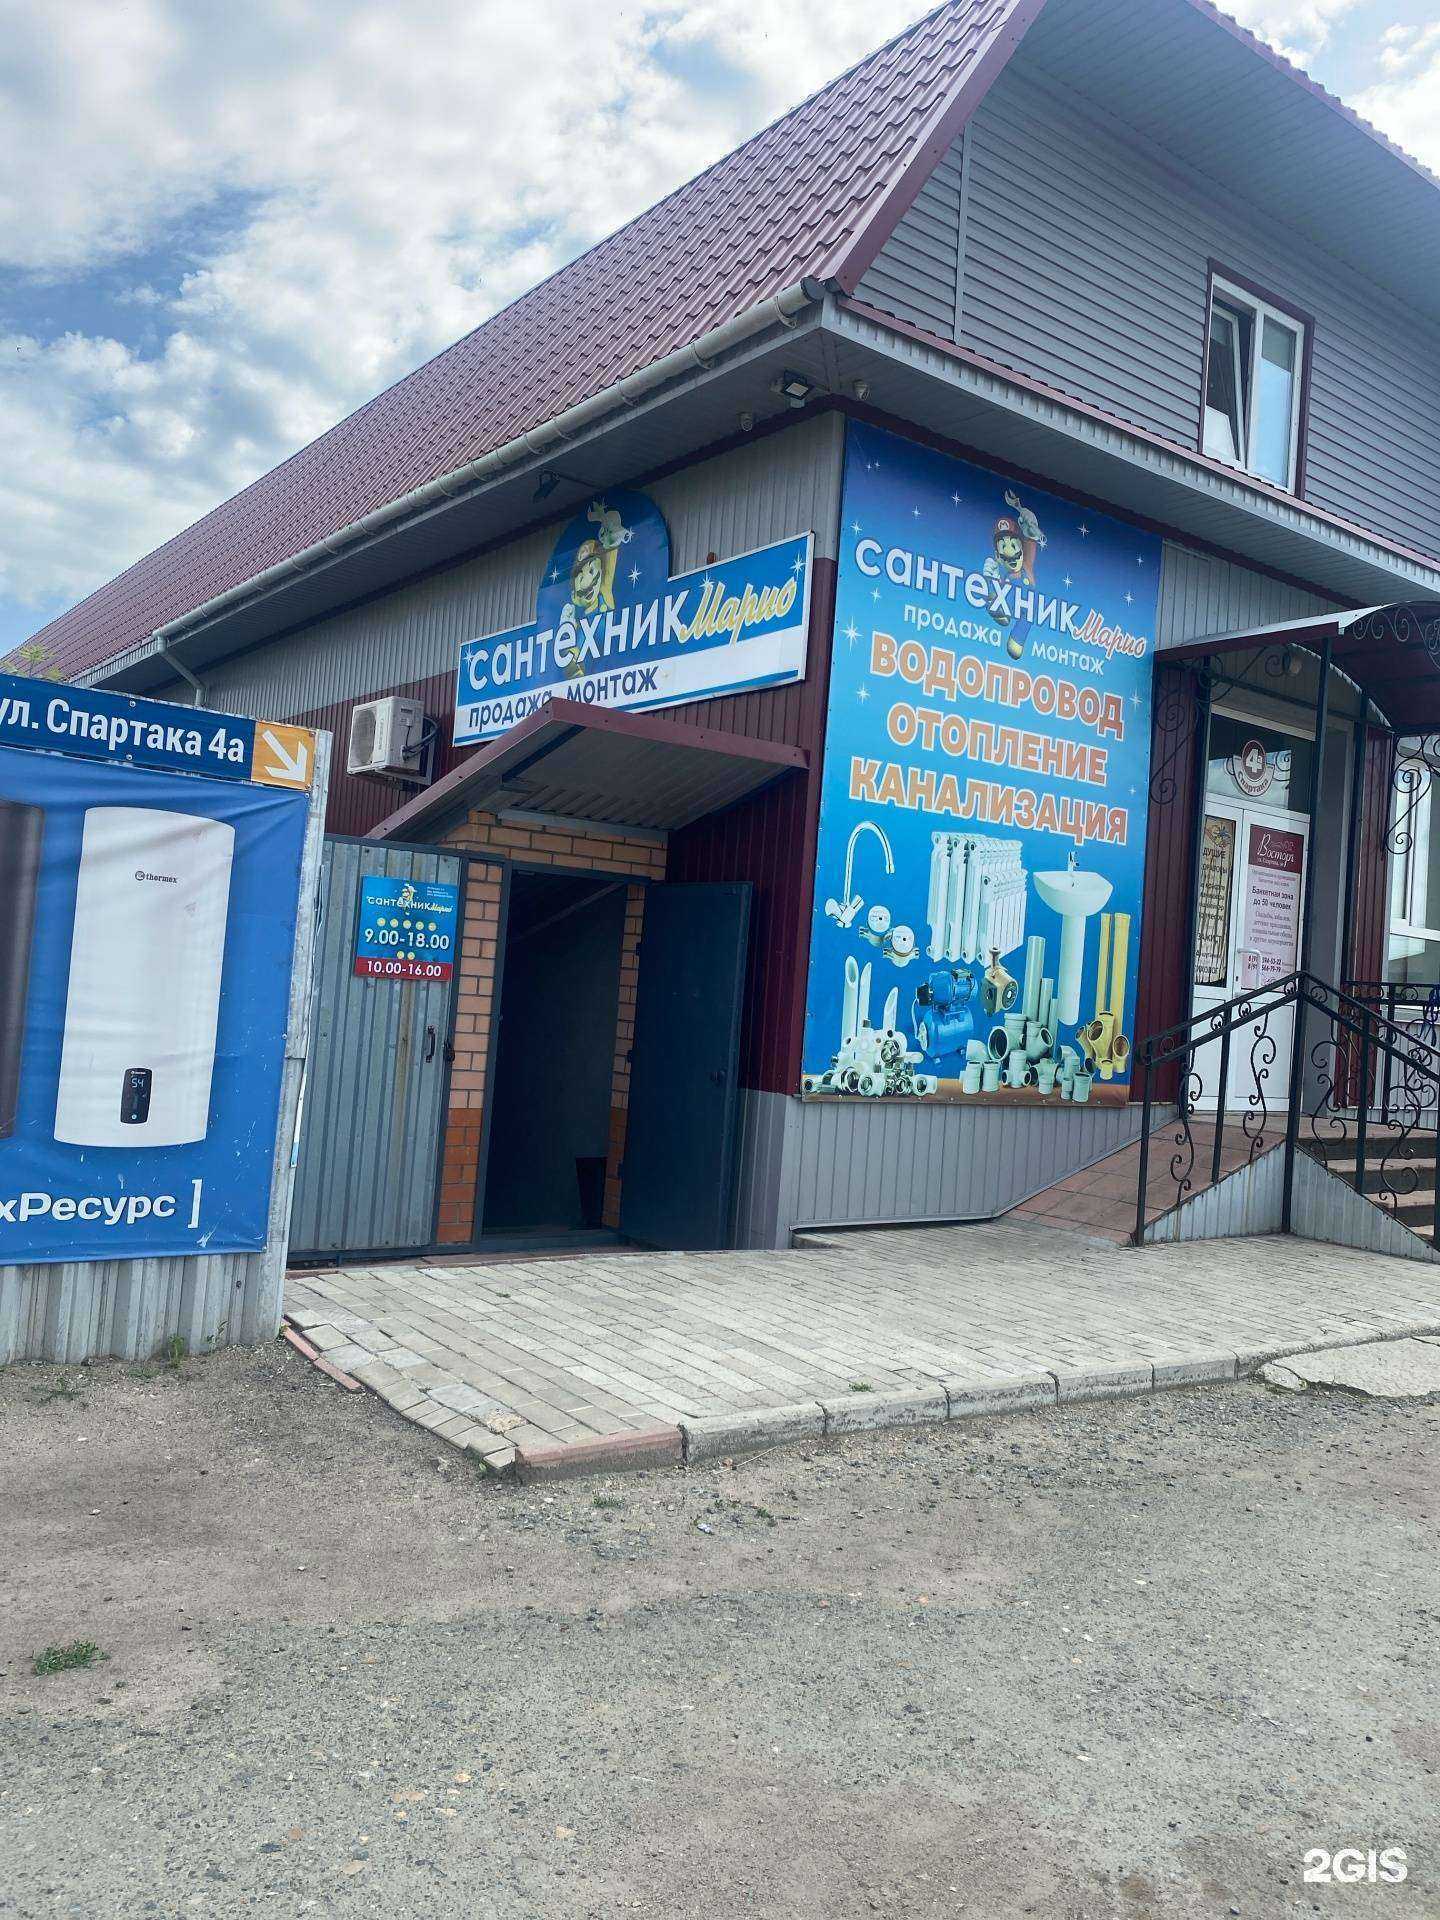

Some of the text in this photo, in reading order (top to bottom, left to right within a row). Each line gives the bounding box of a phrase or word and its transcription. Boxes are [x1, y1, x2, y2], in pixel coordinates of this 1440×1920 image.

[679, 576, 798, 648] Марио
[904, 604, 1104, 677] продажа монтаж
[1073, 608, 1147, 660] Марио
[567, 664, 658, 706] монтаж
[870, 630, 1125, 741] ВОДОПРОВОД
[46, 698, 202, 757] Спартака
[208, 727, 246, 764] 4а
[887, 702, 1108, 786] ОТОПЛЕНИЕ
[849, 756, 1128, 846] КАНАЛИЗАЦИЯ
[365, 928, 450, 950] 9.00-18.00
[367, 961, 442, 977] 10.00-16.00
